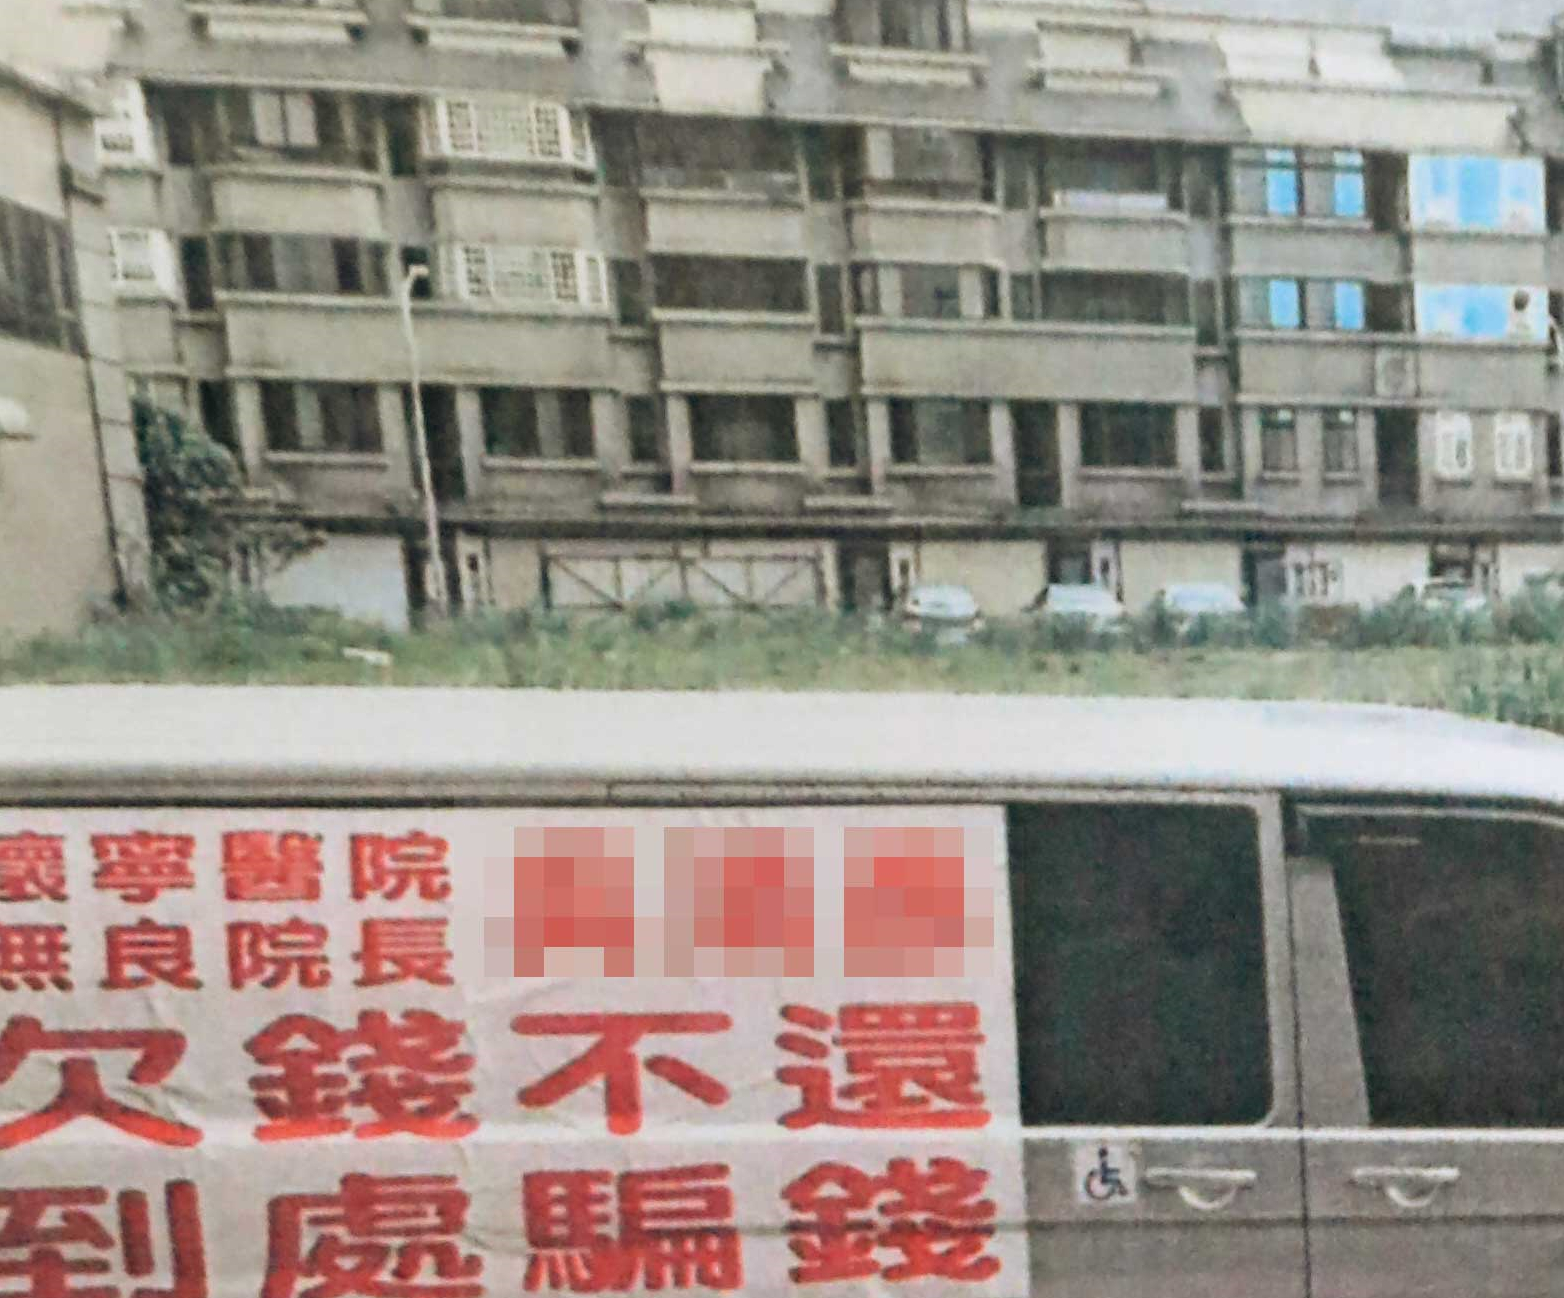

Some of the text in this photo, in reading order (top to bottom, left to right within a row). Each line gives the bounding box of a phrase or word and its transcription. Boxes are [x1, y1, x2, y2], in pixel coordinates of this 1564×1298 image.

[0, 917, 455, 991] 無良院長
[0, 1002, 991, 1146] 欠錢不還
